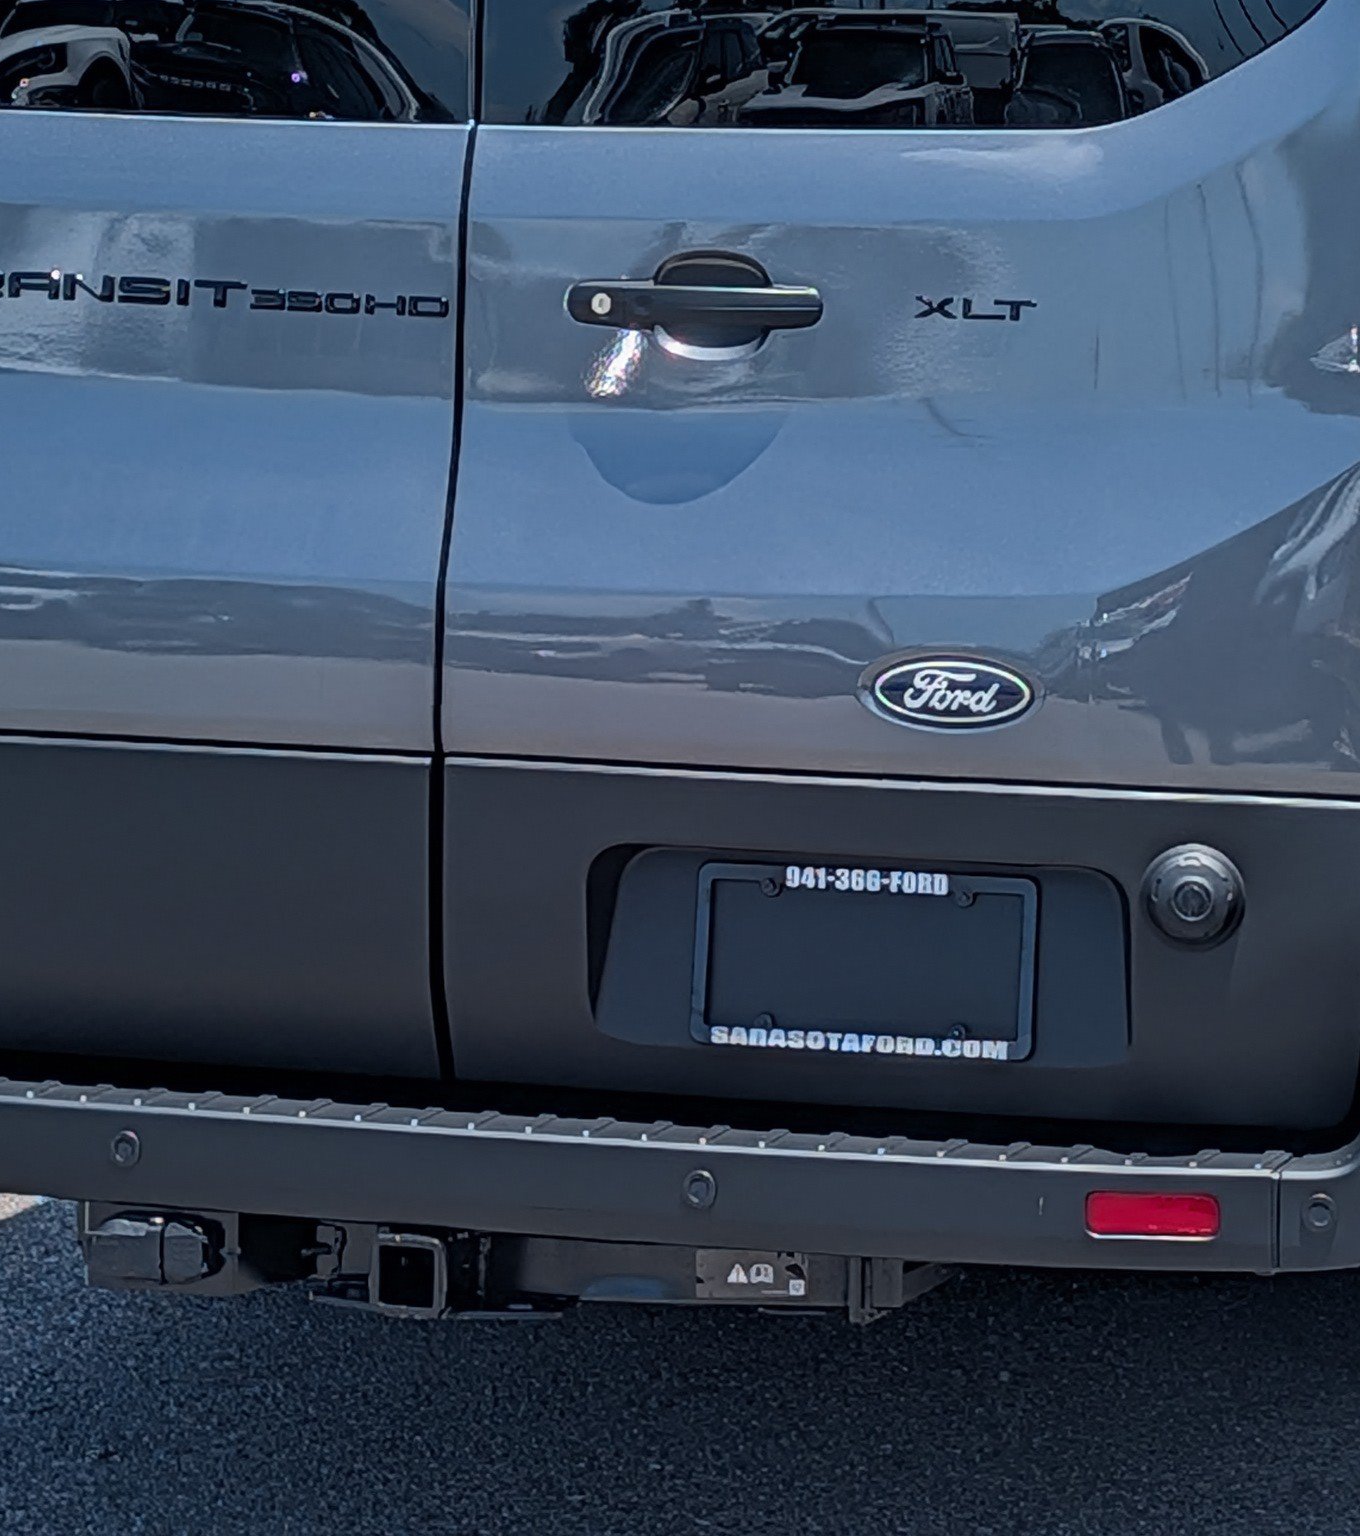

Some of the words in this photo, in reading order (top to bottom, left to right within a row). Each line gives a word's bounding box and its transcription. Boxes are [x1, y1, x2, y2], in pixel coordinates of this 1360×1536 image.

[914, 295, 1038, 322] XLT
[903, 669, 1000, 714] Ford
[785, 865, 949, 896] 941-366-FORD
[710, 1026, 1009, 1061] SARASOTAFORD.COM
